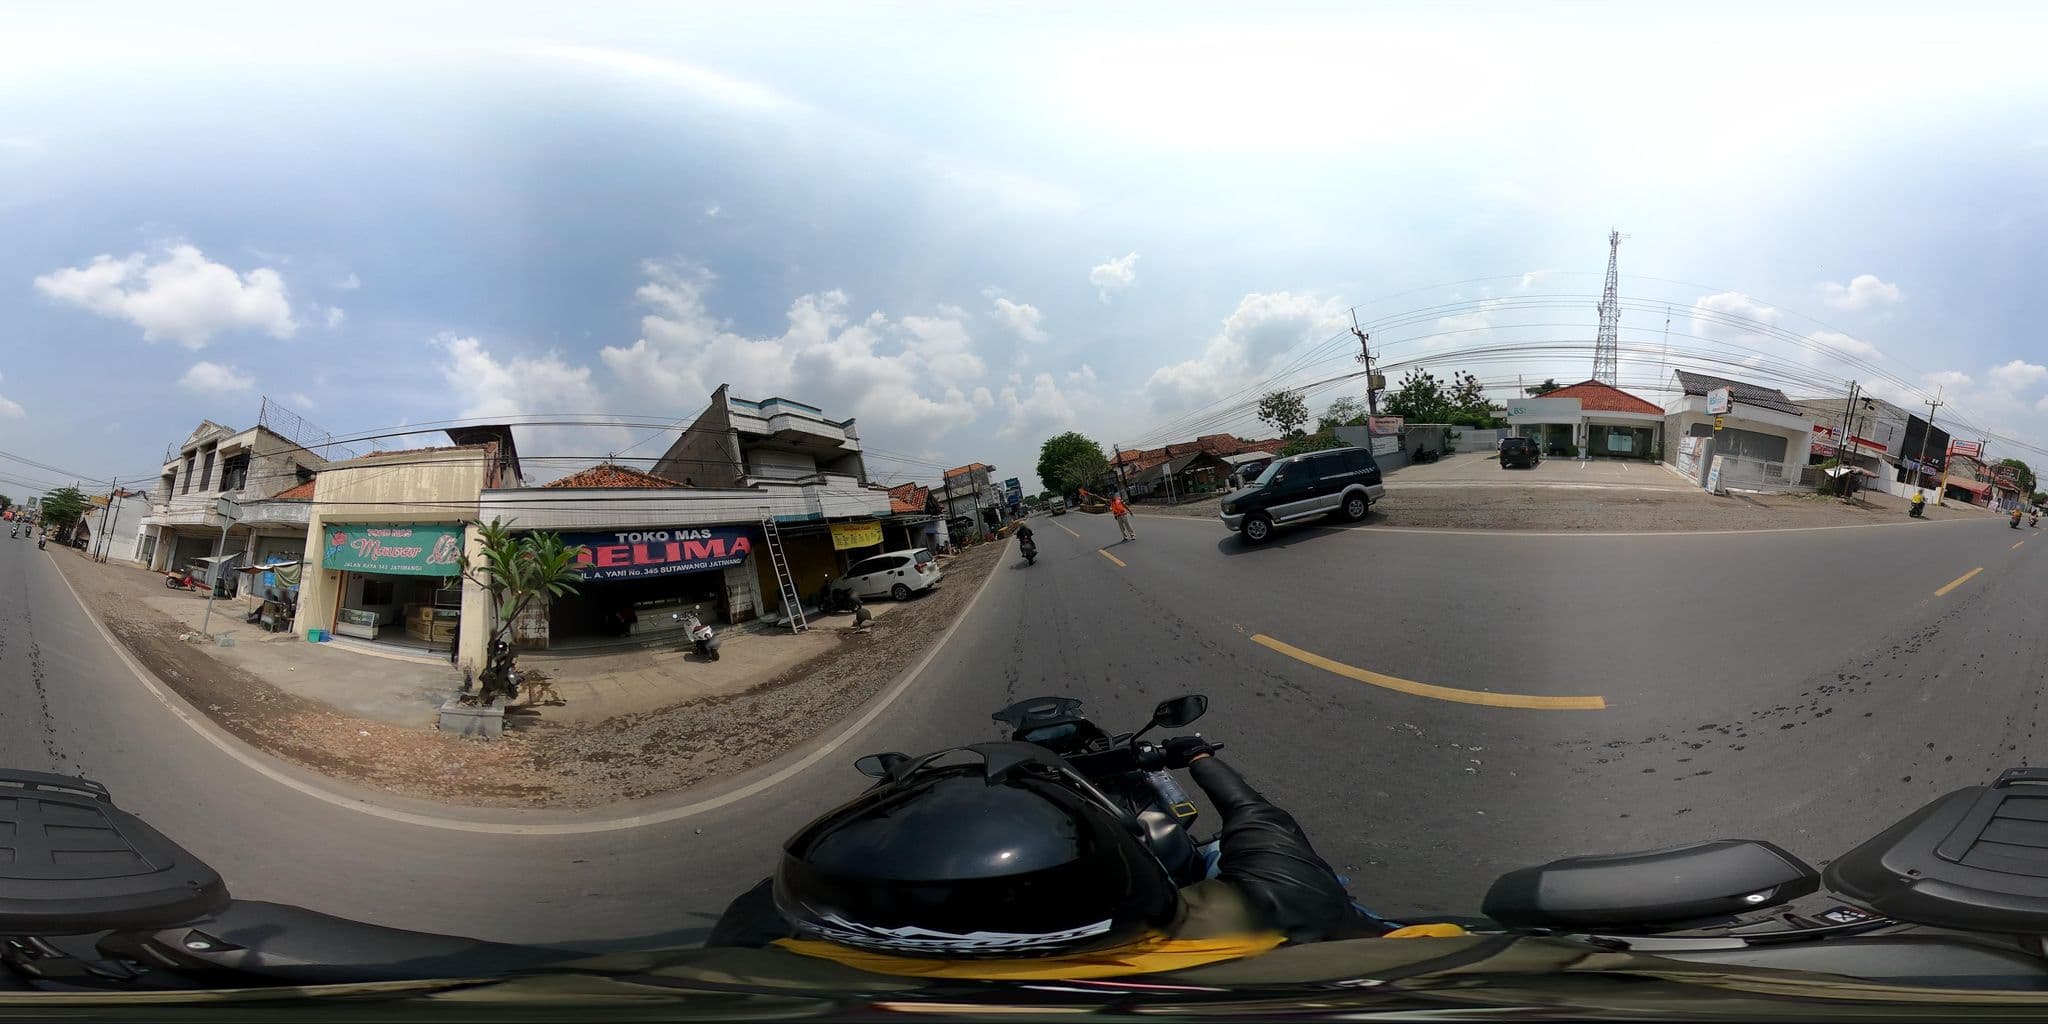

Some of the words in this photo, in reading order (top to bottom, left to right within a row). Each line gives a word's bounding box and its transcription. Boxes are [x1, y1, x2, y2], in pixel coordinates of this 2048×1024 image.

[615, 531, 669, 544] TOKO
[675, 529, 712, 541] MAS
[606, 569, 627, 577] YANI
[660, 562, 708, 574] SUTAWANGI
